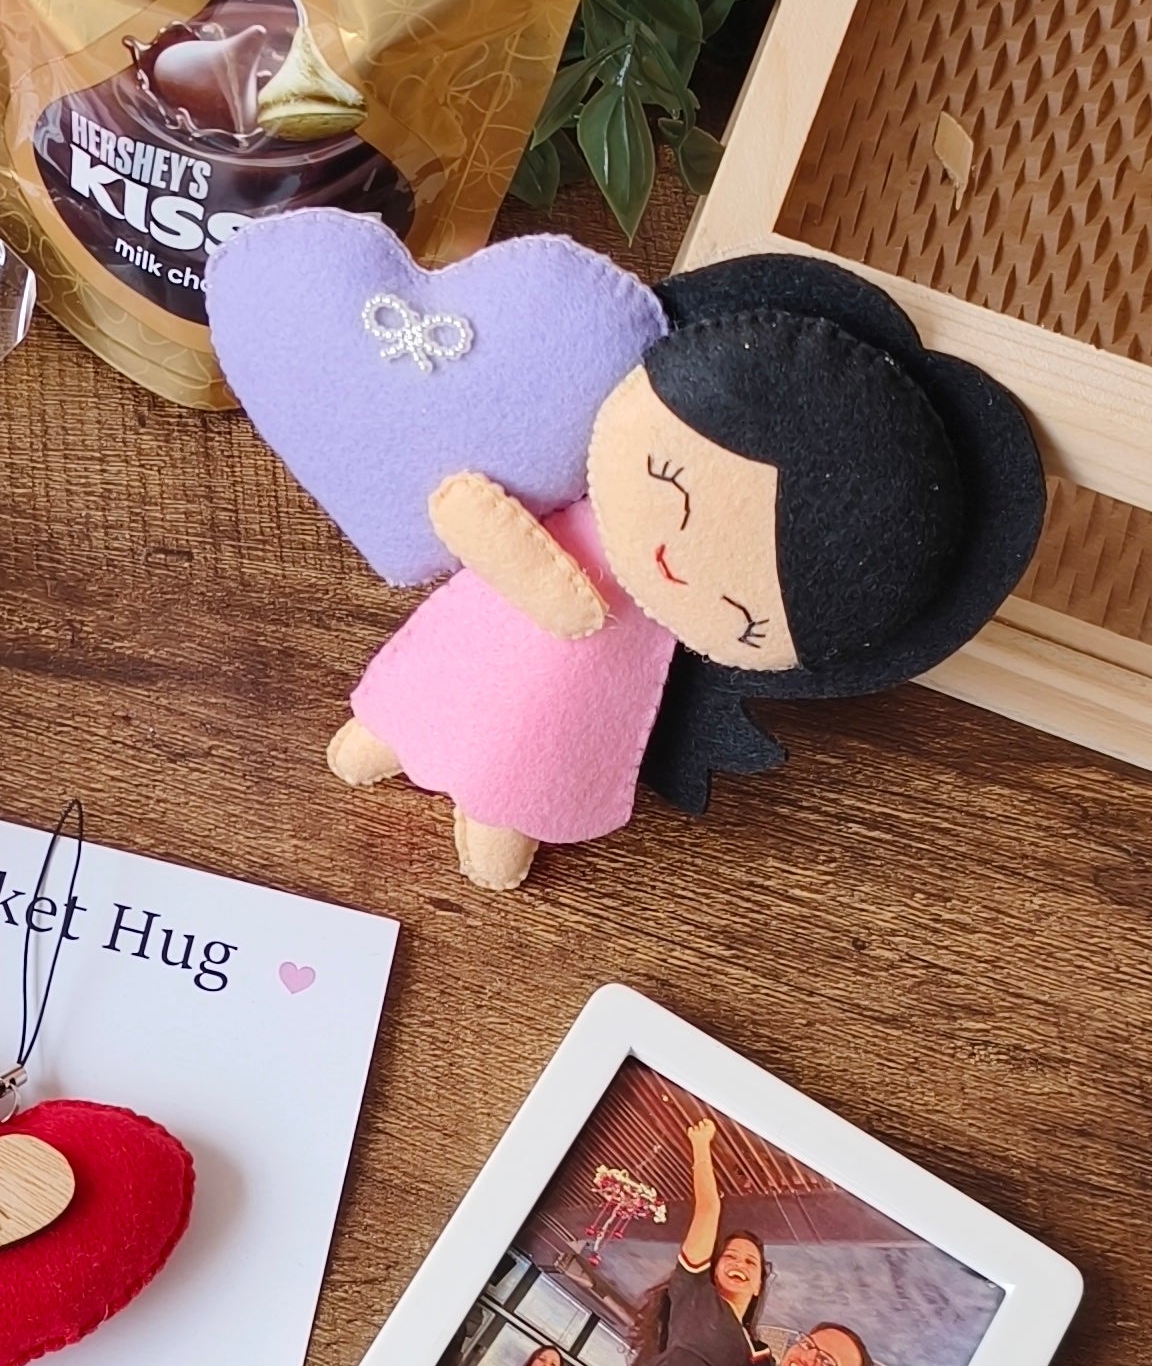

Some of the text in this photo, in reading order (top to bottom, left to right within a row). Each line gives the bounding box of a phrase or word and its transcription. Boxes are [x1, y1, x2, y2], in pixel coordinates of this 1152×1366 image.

[70, 110, 212, 200] HERSHEY'S
[70, 143, 254, 256] KISS
[114, 237, 163, 278] milk
[102, 903, 238, 993] Hug
